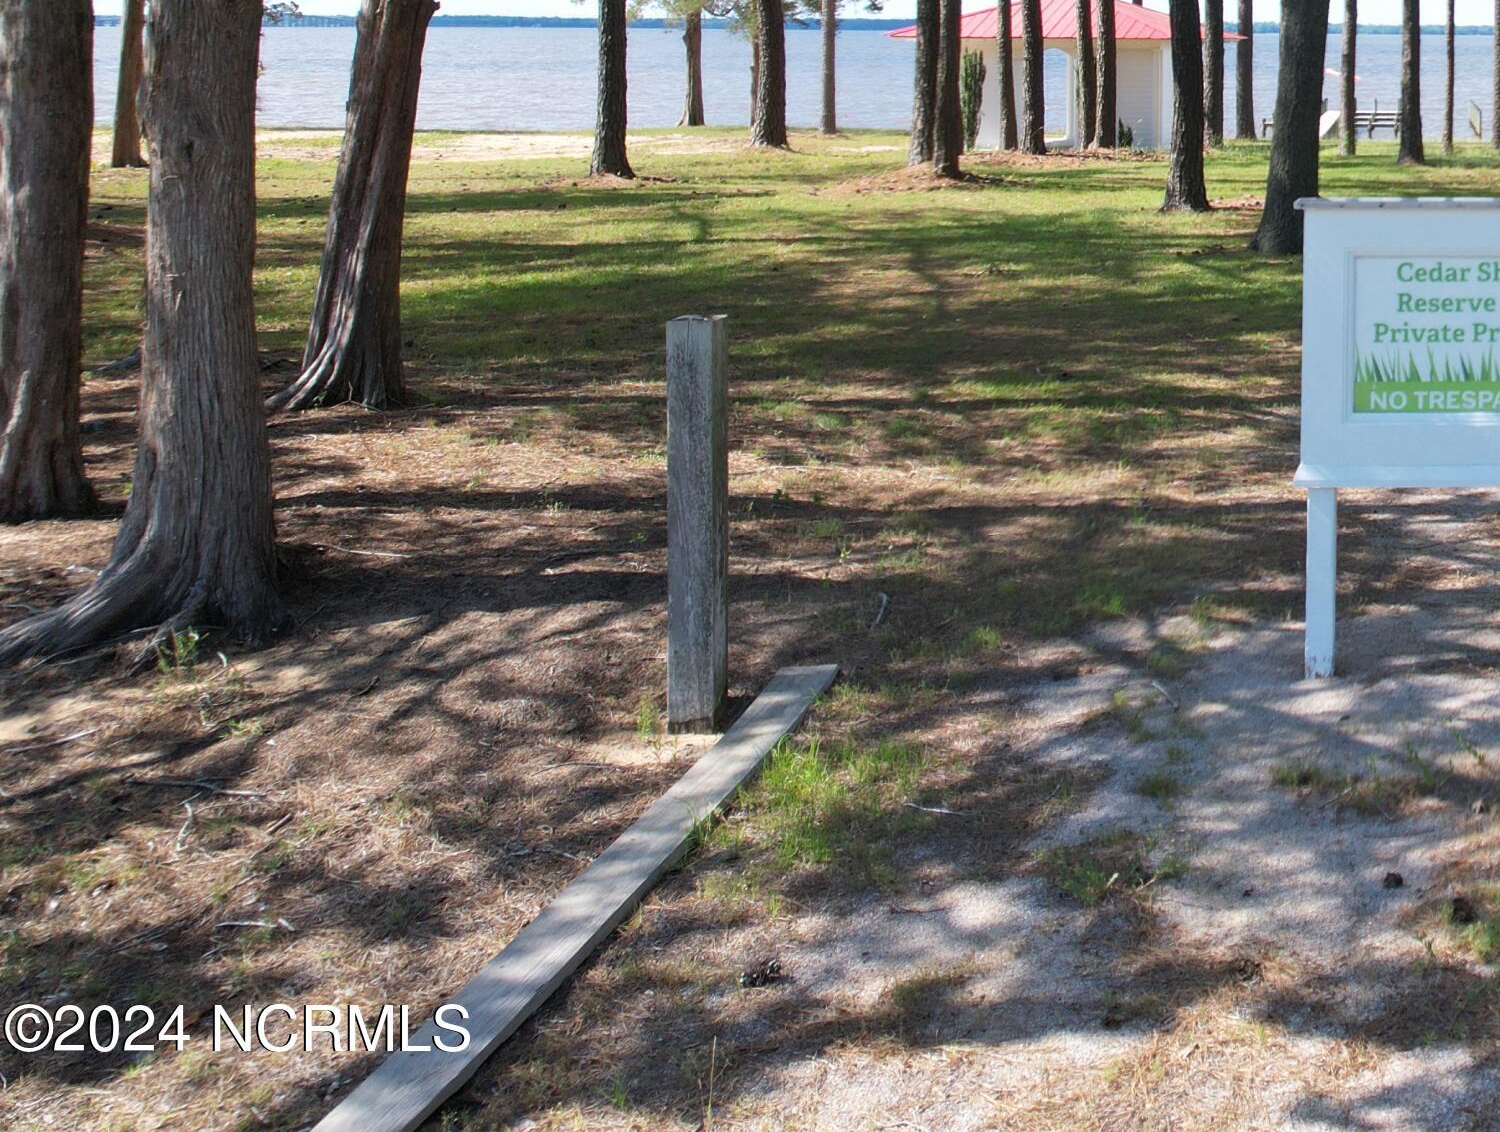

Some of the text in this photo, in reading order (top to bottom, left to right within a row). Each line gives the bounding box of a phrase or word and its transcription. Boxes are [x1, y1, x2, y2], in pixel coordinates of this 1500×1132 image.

[1396, 261, 1471, 283] Cedar
[1396, 292, 1496, 313] Reserve
[1373, 322, 1465, 343] Private
[1369, 390, 1408, 410] NO
